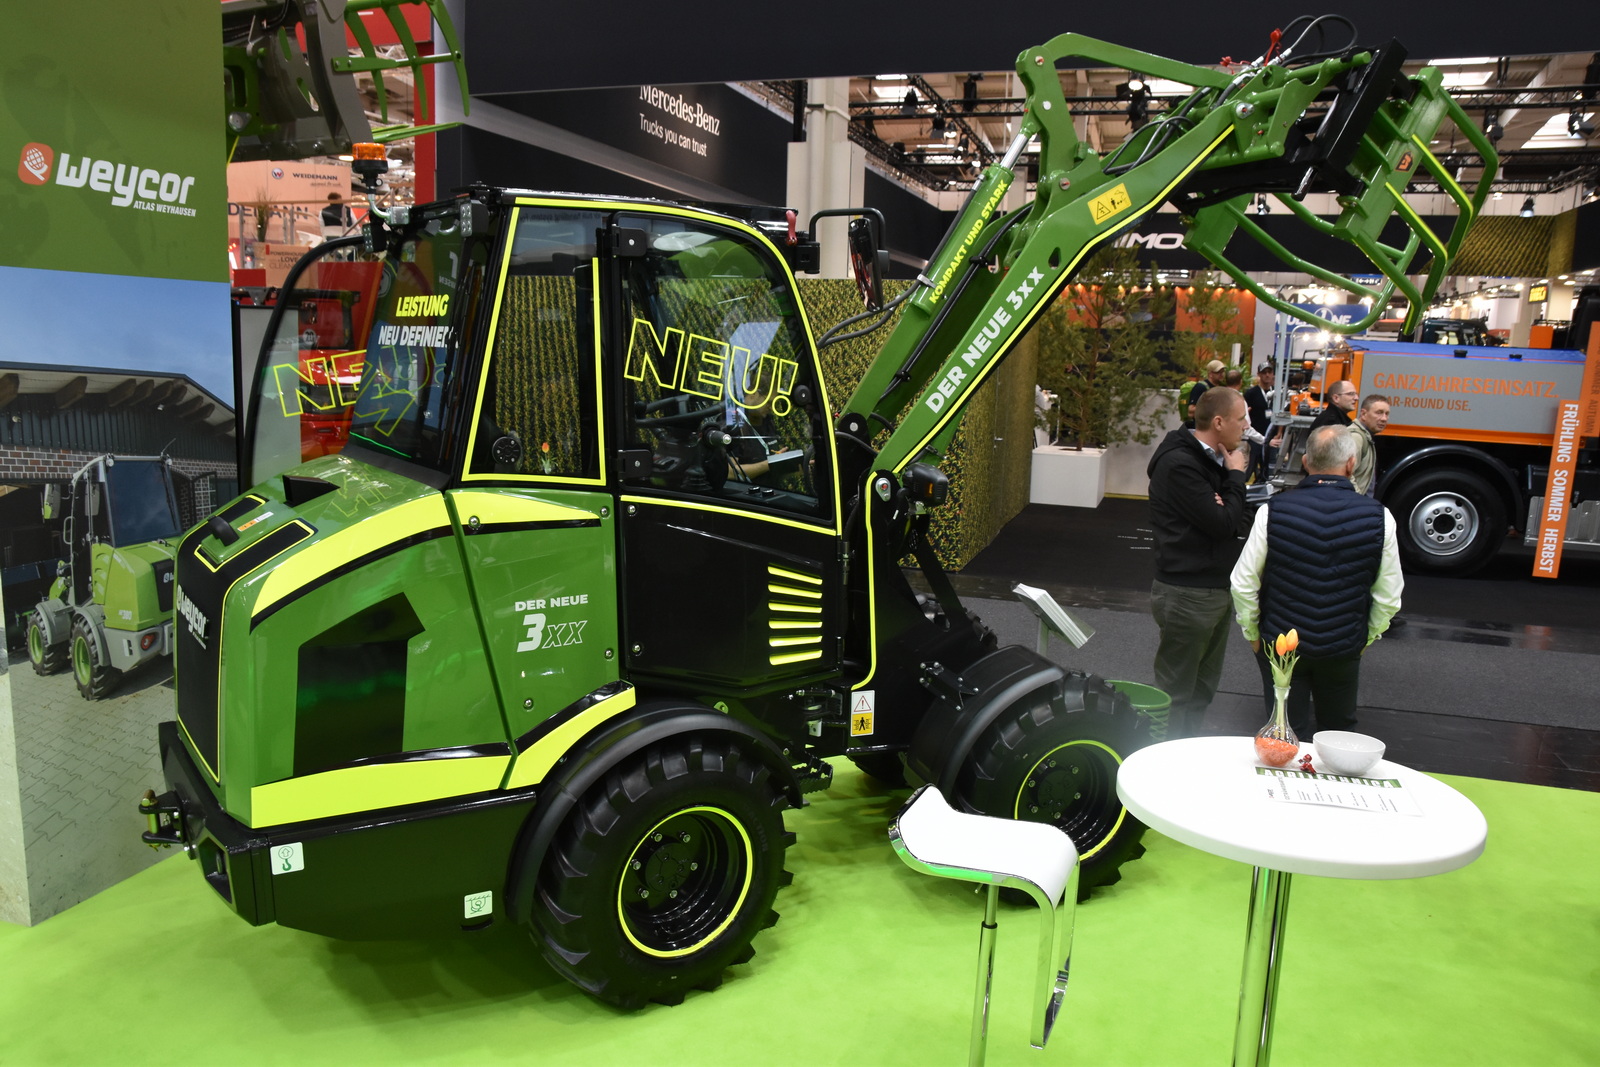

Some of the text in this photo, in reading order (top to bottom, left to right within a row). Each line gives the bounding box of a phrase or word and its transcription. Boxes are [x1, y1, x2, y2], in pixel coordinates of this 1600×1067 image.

[639, 85, 720, 136] Mercedes-Benz
[640, 113, 707, 157] Trucks you can trust
[55, 152, 195, 208] weycor
[293, 172, 338, 181] WEIDEMANN
[133, 200, 197, 218] ATLAS WEYHAUSEN
[929, 179, 1008, 304] KOMPAKT UND STARK
[396, 294, 449, 317] LEISTUNG
[378, 325, 459, 349] NEU DEFINIE
[624, 318, 799, 417] NEU!
[925, 366, 967, 414] DER
[961, 306, 1012, 368] NEUE
[1373, 372, 1559, 399] GANZJAHRESEINSATZ.
[1388, 395, 1472, 412] AR-ROUND USE.
[1585, 399, 1598, 434] AUTUMN
[1539, 403, 1579, 573] FRÜHLING SOMMER HERBST
[514, 594, 589, 612] DER NEUE
